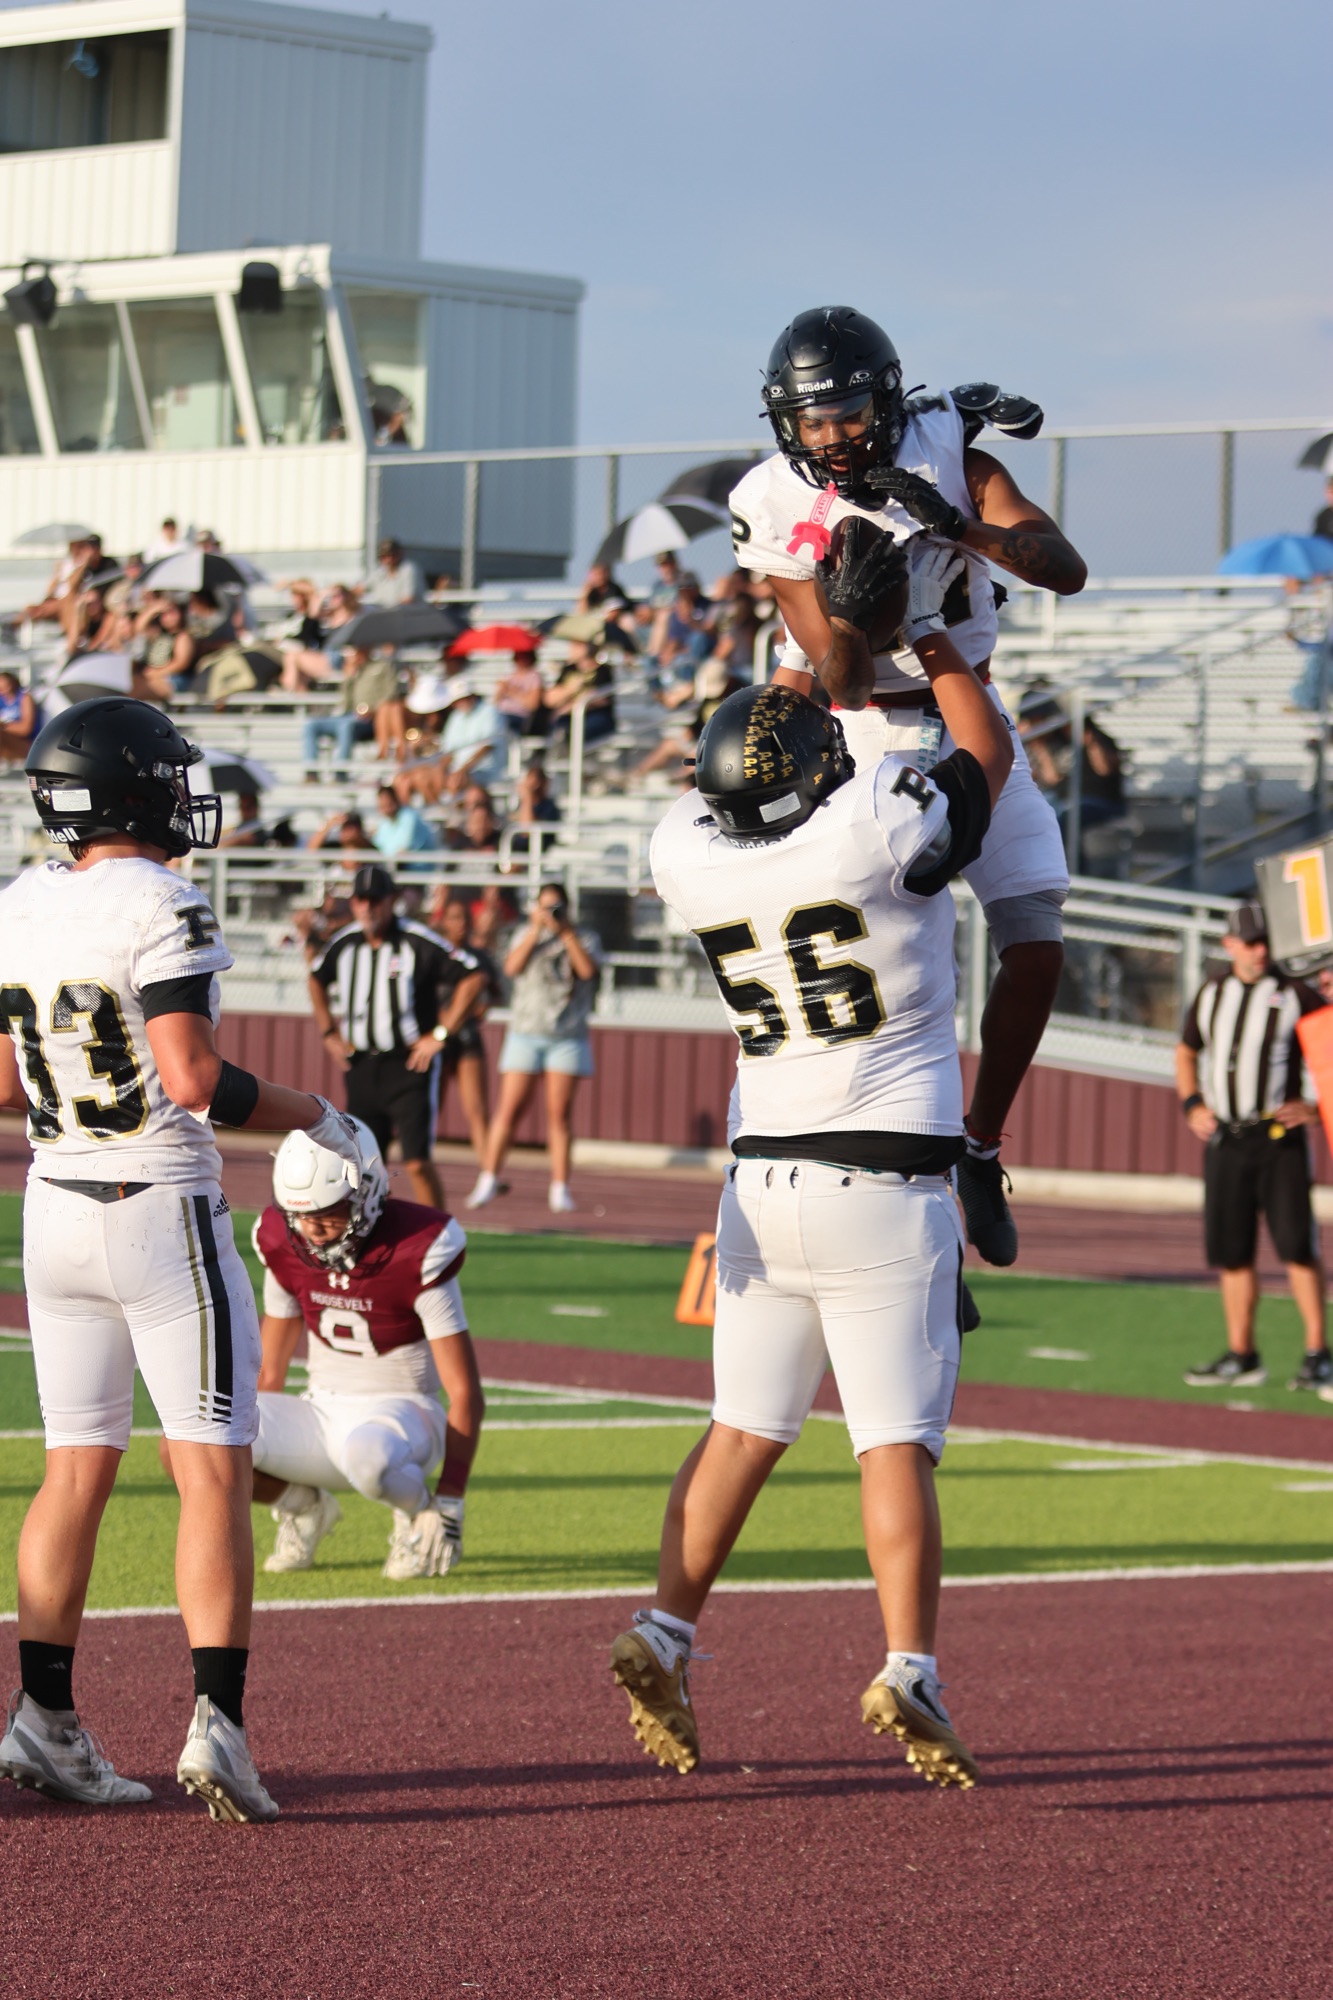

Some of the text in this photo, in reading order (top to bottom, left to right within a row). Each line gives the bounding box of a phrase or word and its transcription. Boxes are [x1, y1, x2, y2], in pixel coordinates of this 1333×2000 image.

[744, 746, 757, 755] P
[758, 751, 772, 760] P
[744, 758, 757, 767] P
[761, 761, 774, 772] P
[744, 768, 758, 778] P
[762, 773, 775, 784] P
[813, 772, 823, 785] P
[890, 766, 937, 815] P
[1284, 848, 1332, 946] 1
[173, 904, 220, 951] P
[691, 899, 888, 1059] 56
[0, 977, 149, 1144] 33
[695, 1244, 717, 1313] 1
[310, 1291, 373, 1311] ROOSEVELT
